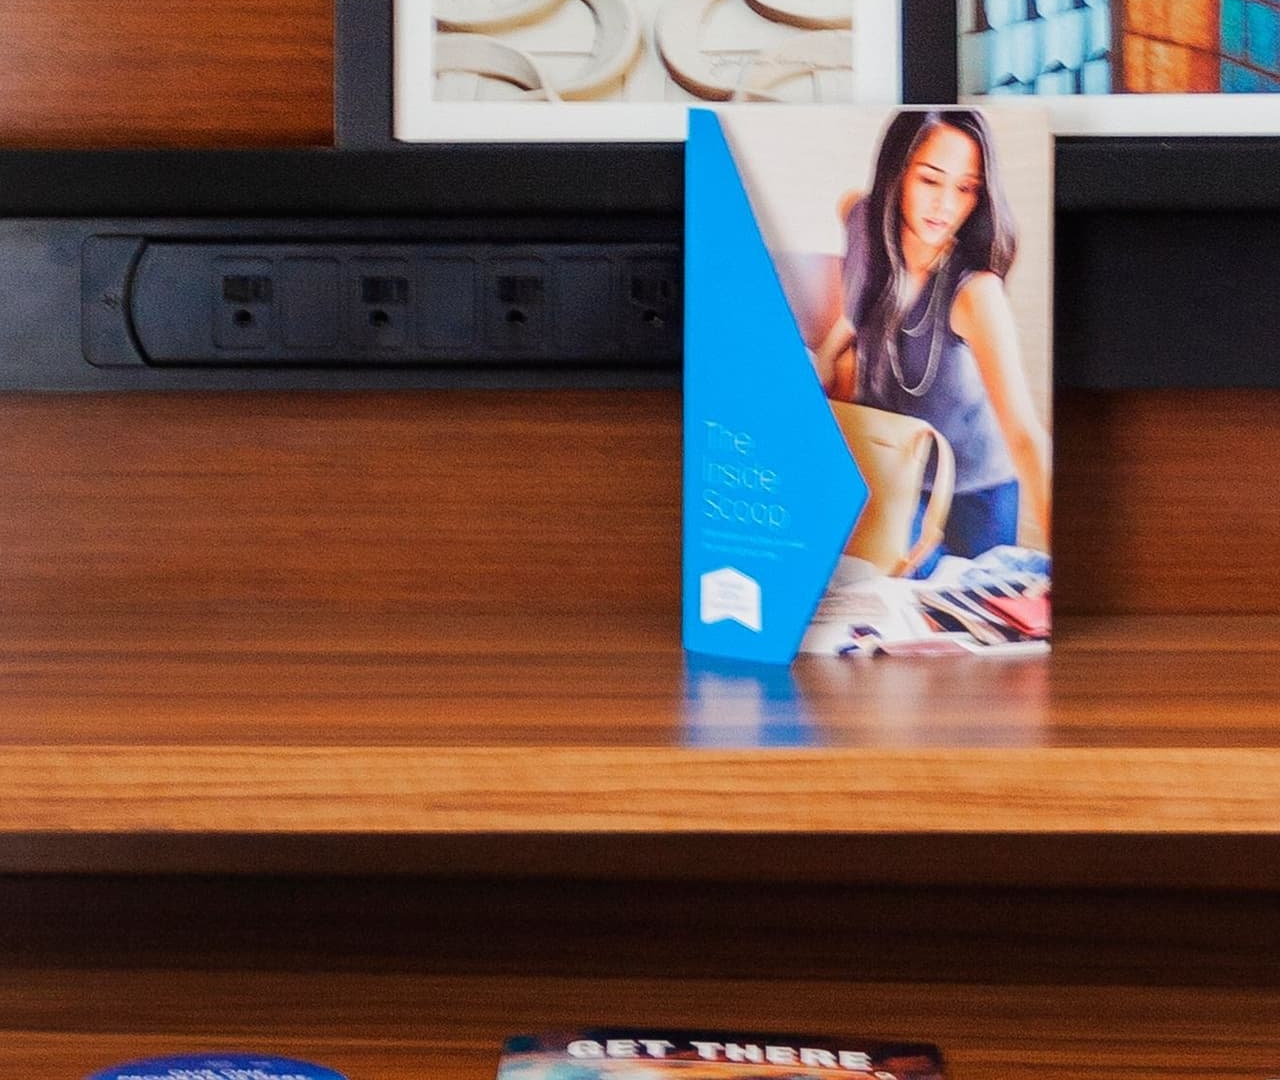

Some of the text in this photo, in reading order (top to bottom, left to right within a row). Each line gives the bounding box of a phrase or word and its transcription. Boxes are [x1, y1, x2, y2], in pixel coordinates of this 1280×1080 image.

[703, 488, 790, 531] Scoop
[567, 1039, 874, 1071] GET THERE
